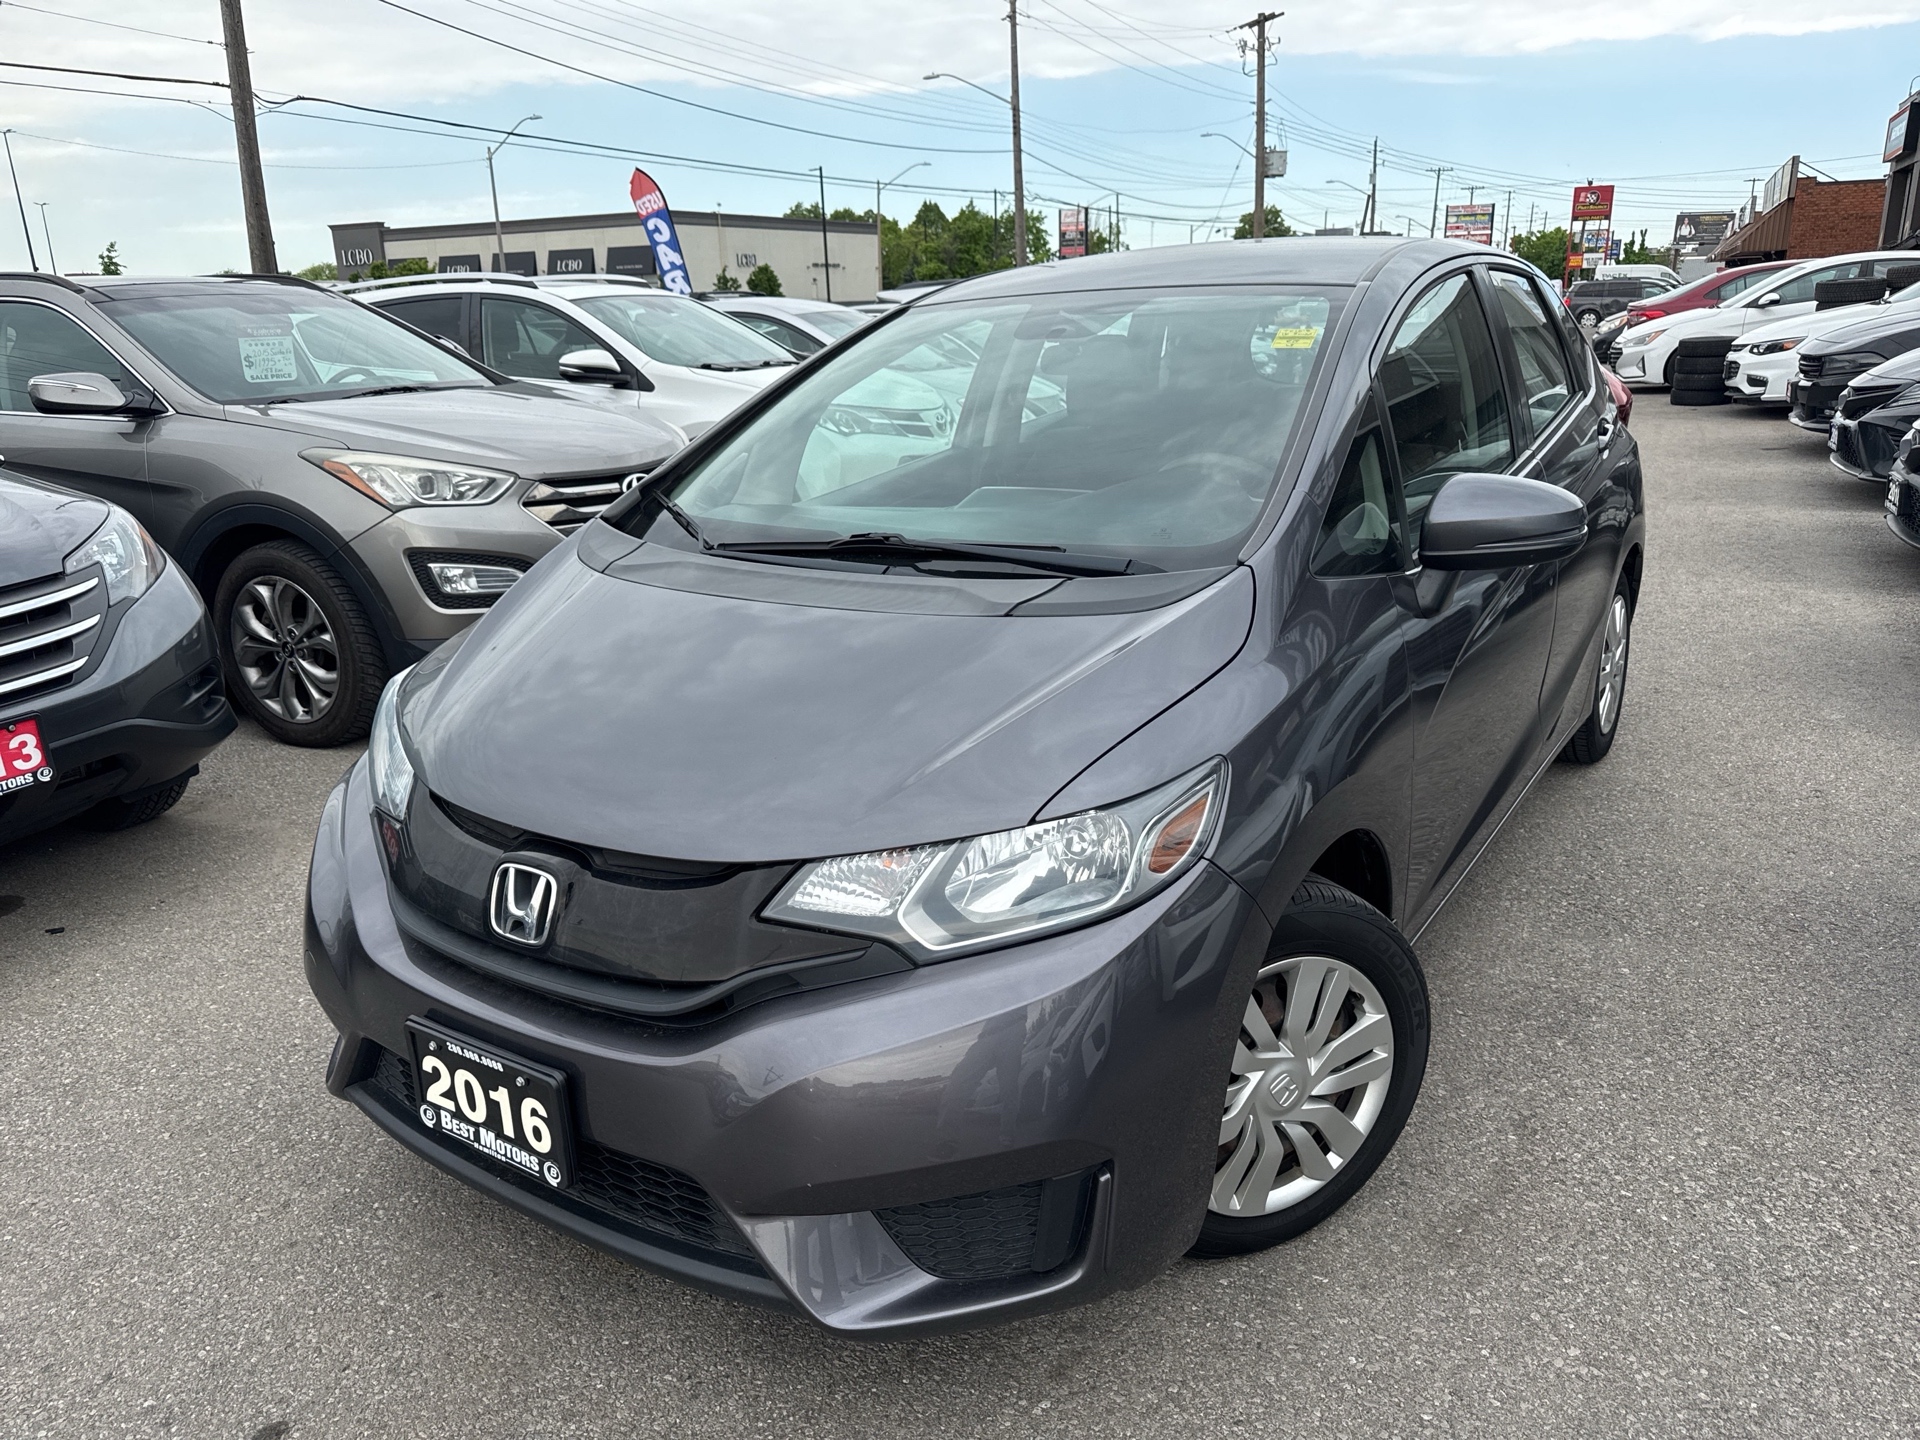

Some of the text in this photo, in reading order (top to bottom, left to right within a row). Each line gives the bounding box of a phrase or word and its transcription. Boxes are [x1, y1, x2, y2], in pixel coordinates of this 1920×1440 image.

[341, 248, 373, 266] LCBO
[557, 259, 582, 272] LCBO
[0, 772, 34, 791] TORS
[421, 1055, 552, 1154] 2016
[440, 1109, 540, 1172] BEST MOTORS
